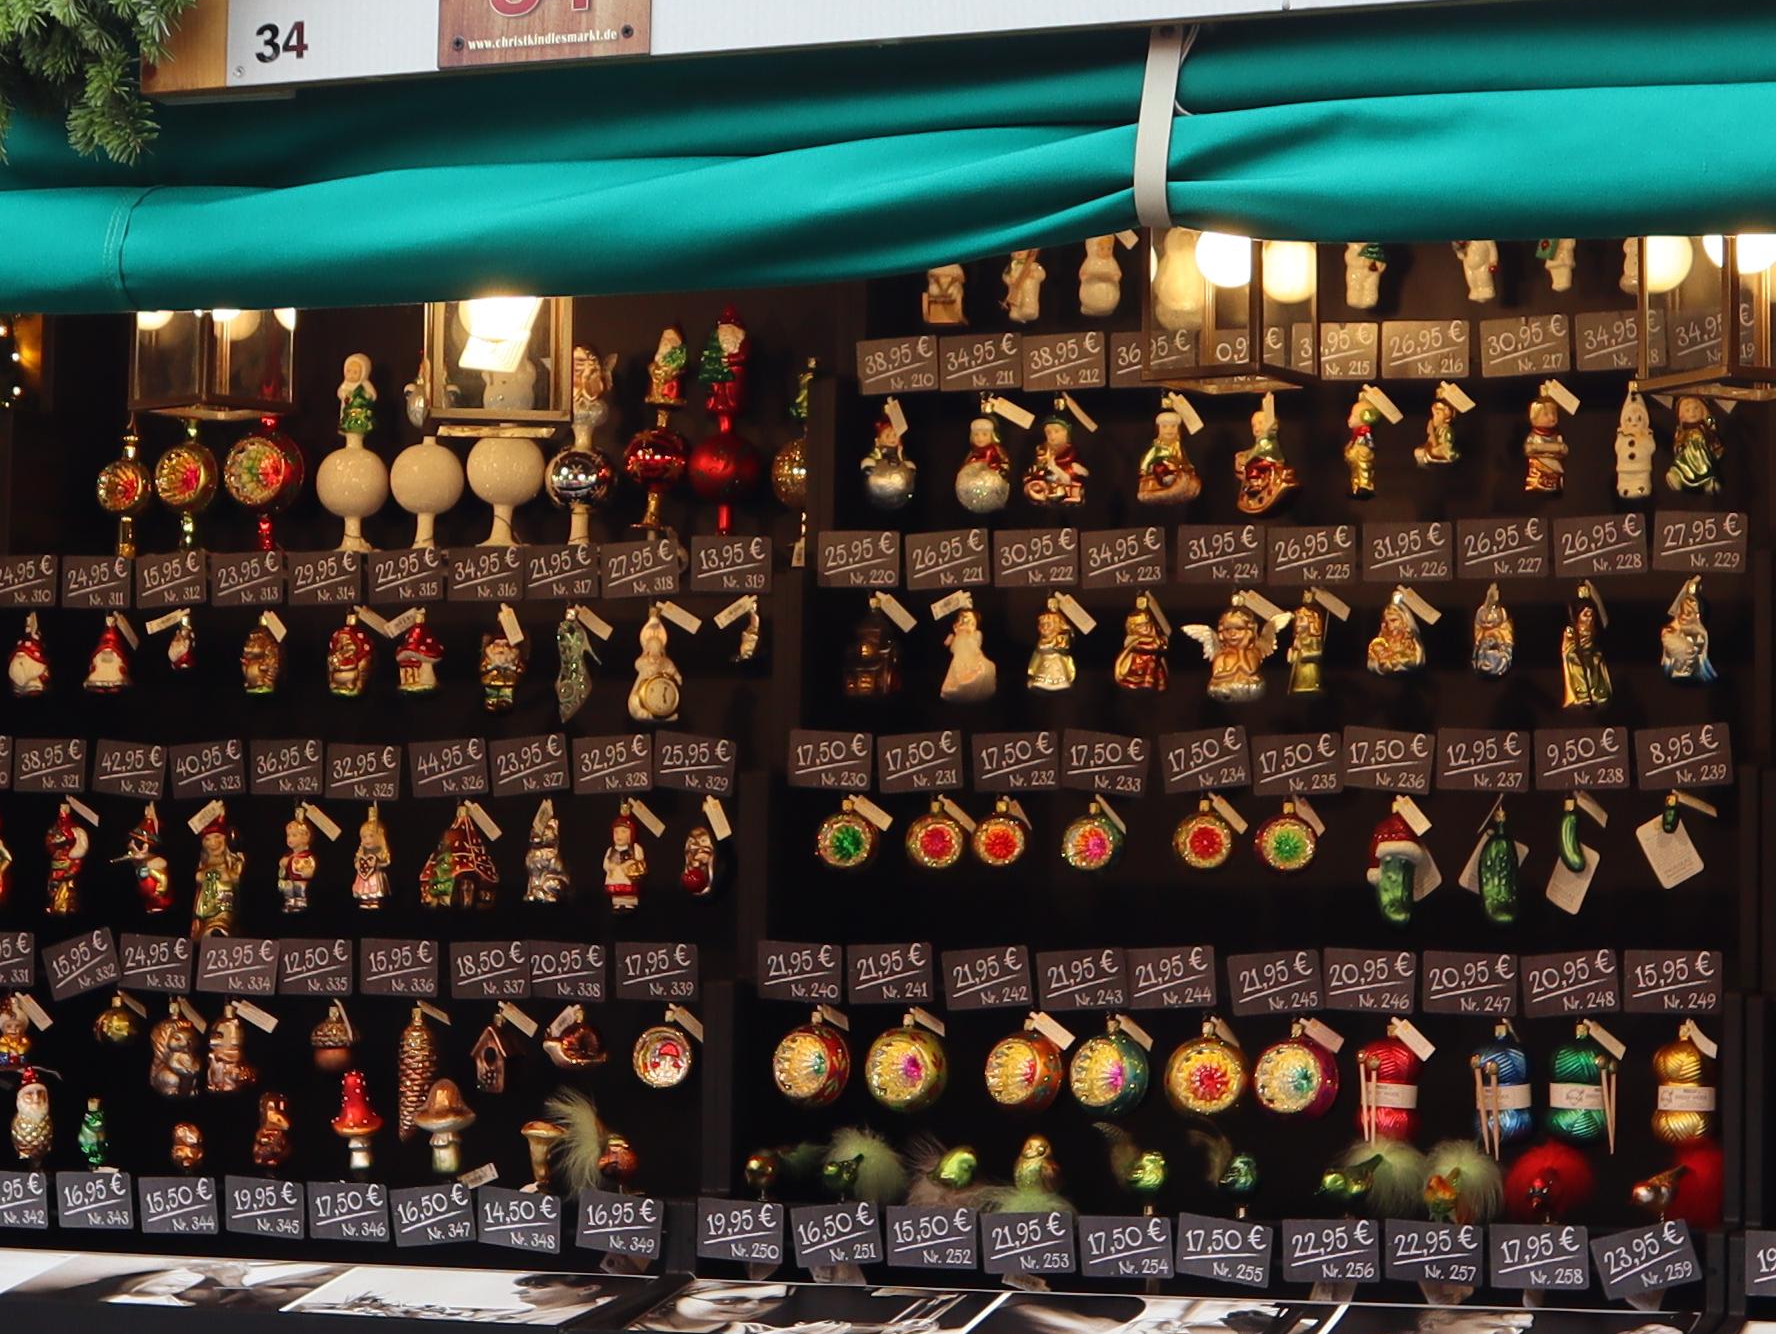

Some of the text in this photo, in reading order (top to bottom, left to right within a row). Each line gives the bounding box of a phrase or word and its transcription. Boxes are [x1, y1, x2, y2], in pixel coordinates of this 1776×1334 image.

[254, 20, 309, 63] 34
[466, 29, 618, 51] www.christkindlesmarkt.de
[1030, 331, 1100, 369] 38,95 €
[1056, 369, 1100, 385] Nr. 212
[1001, 528, 1076, 566] 30,95 €
[1465, 518, 1543, 557] 26,95 €
[700, 537, 765, 569] 13,95 €
[1028, 566, 1073, 583] Nr. 222
[1494, 558, 1542, 574] Nr. 227
[724, 575, 764, 588] Nr. 319
[22, 739, 82, 771] 38,95 €
[581, 734, 648, 772] 32,95 €
[981, 732, 1054, 769] 17,50 €
[1547, 728, 1619, 766] 9,50 €
[42, 775, 79, 788] Nr. 321
[606, 772, 648, 789] Nr. 328
[1010, 770, 1055, 787] Nr. 232
[1574, 768, 1624, 785] Nr. 238
[16, 933, 31, 953] €
[369, 941, 432, 972] 15,95 €
[857, 943, 926, 980] 21,95 €
[11, 969, 28, 982] 331
[1635, 951, 1714, 987] 15,95 €
[392, 978, 434, 992] Nr. 336
[882, 983, 927, 999] Nr. 241
[1664, 993, 1716, 1009] Nr. 249
[27, 1173, 43, 1195] €
[316, 1184, 383, 1217] 17,50 €
[4, 1210, 44, 1224] Nr. 342
[894, 1208, 972, 1243] 15,50 €
[342, 1222, 386, 1236] Nr. 346
[1501, 1226, 1580, 1263] 17,95 €
[923, 1249, 972, 1264] Nr. 252
[1530, 1267, 1583, 1284] Nr. 258
